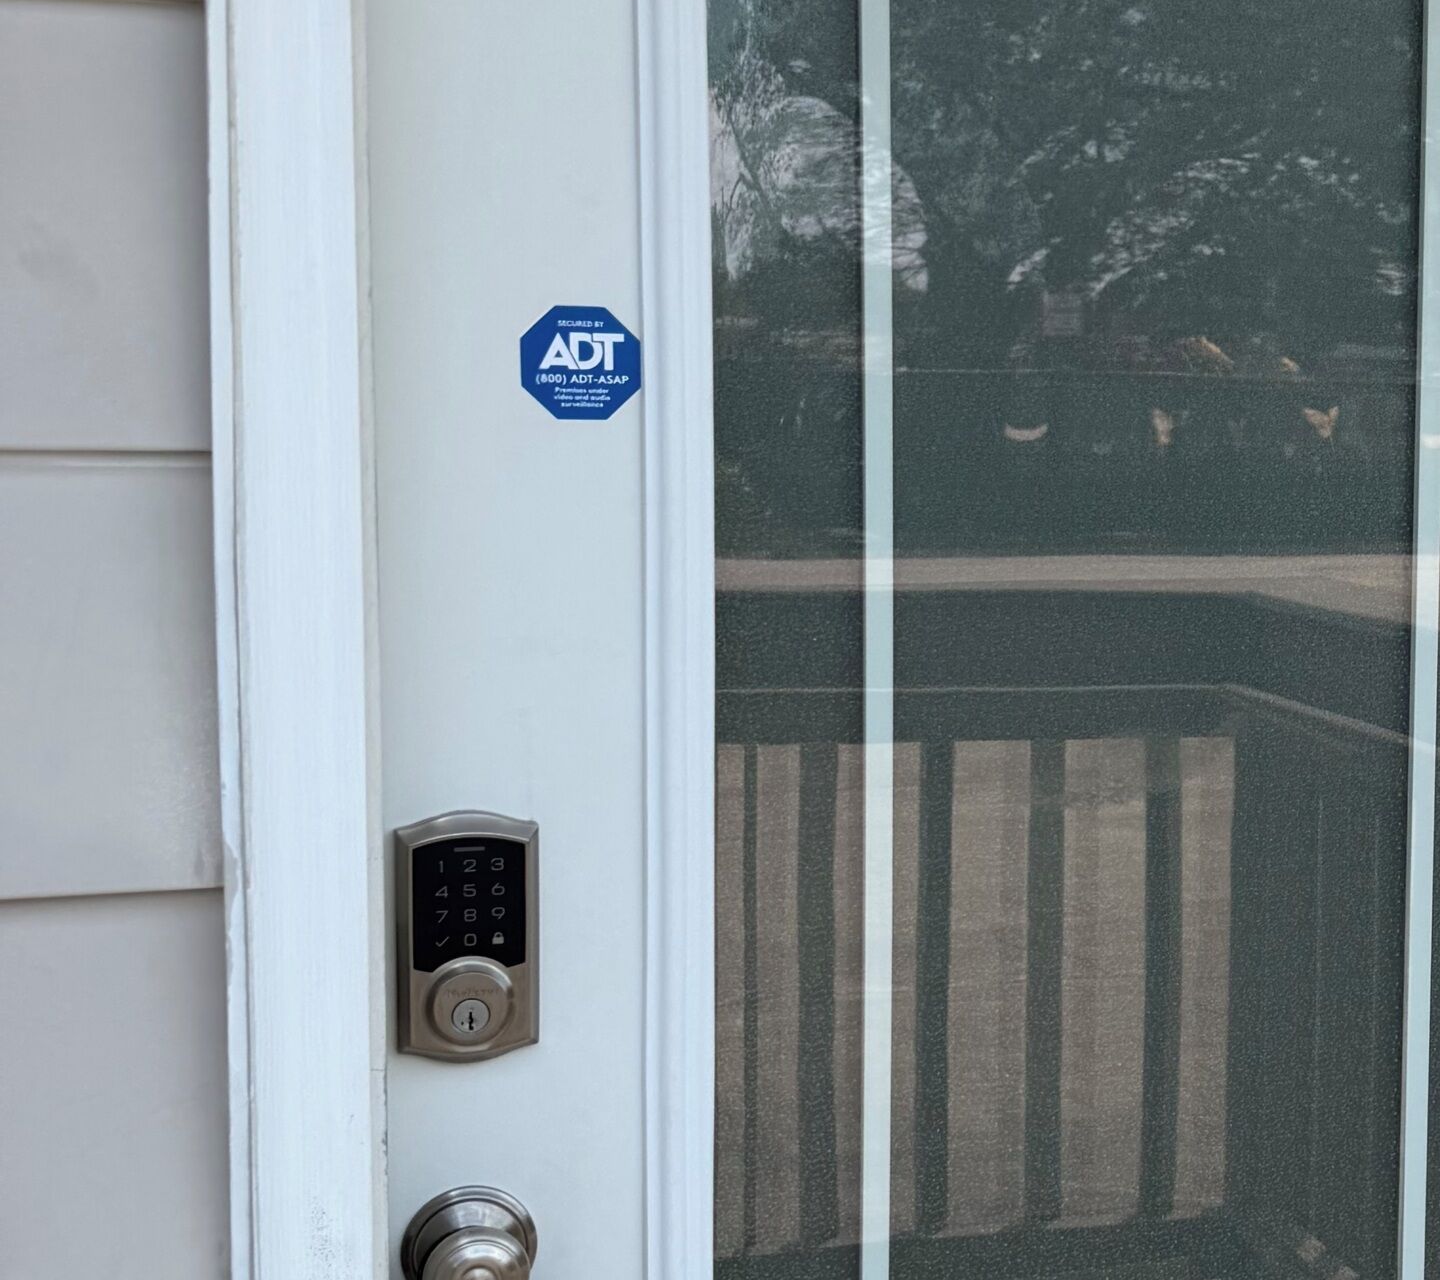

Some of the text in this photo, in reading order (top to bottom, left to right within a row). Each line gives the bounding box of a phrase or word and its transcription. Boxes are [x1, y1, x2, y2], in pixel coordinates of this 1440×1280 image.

[538, 331, 625, 371] ADT
[535, 373, 630, 385] (800) ADT-ASAP
[438, 857, 504, 873] 1 2 3
[435, 882, 505, 898] 4 5 6
[435, 906, 505, 923] 7 8 9
[463, 933, 477, 946] 0
